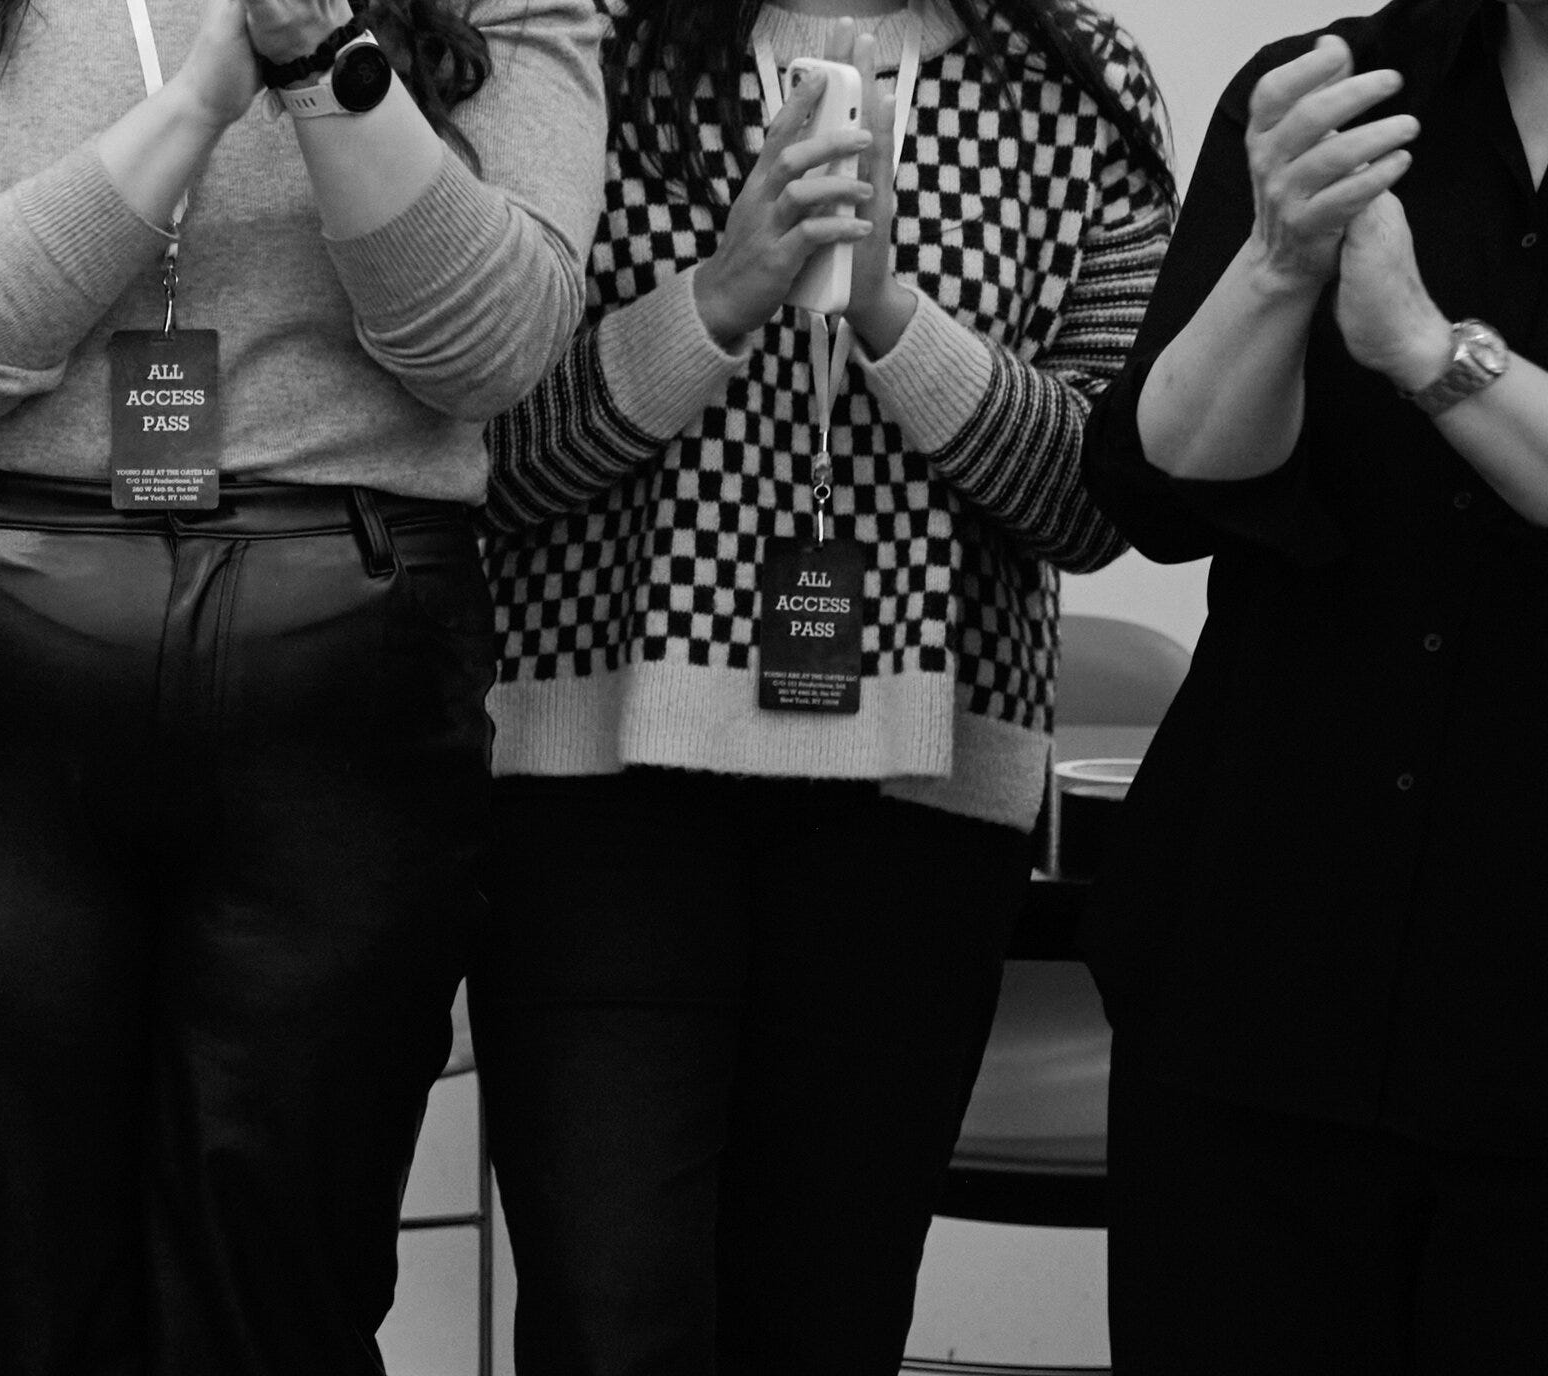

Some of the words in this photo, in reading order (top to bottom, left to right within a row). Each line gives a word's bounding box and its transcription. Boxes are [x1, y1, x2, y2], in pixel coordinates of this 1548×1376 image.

[147, 364, 184, 380] ALL
[125, 390, 205, 406] ACCESS
[142, 415, 190, 432] PASS
[796, 571, 832, 588] ALL
[775, 595, 851, 614] ACCESS
[789, 621, 835, 638] PASS
